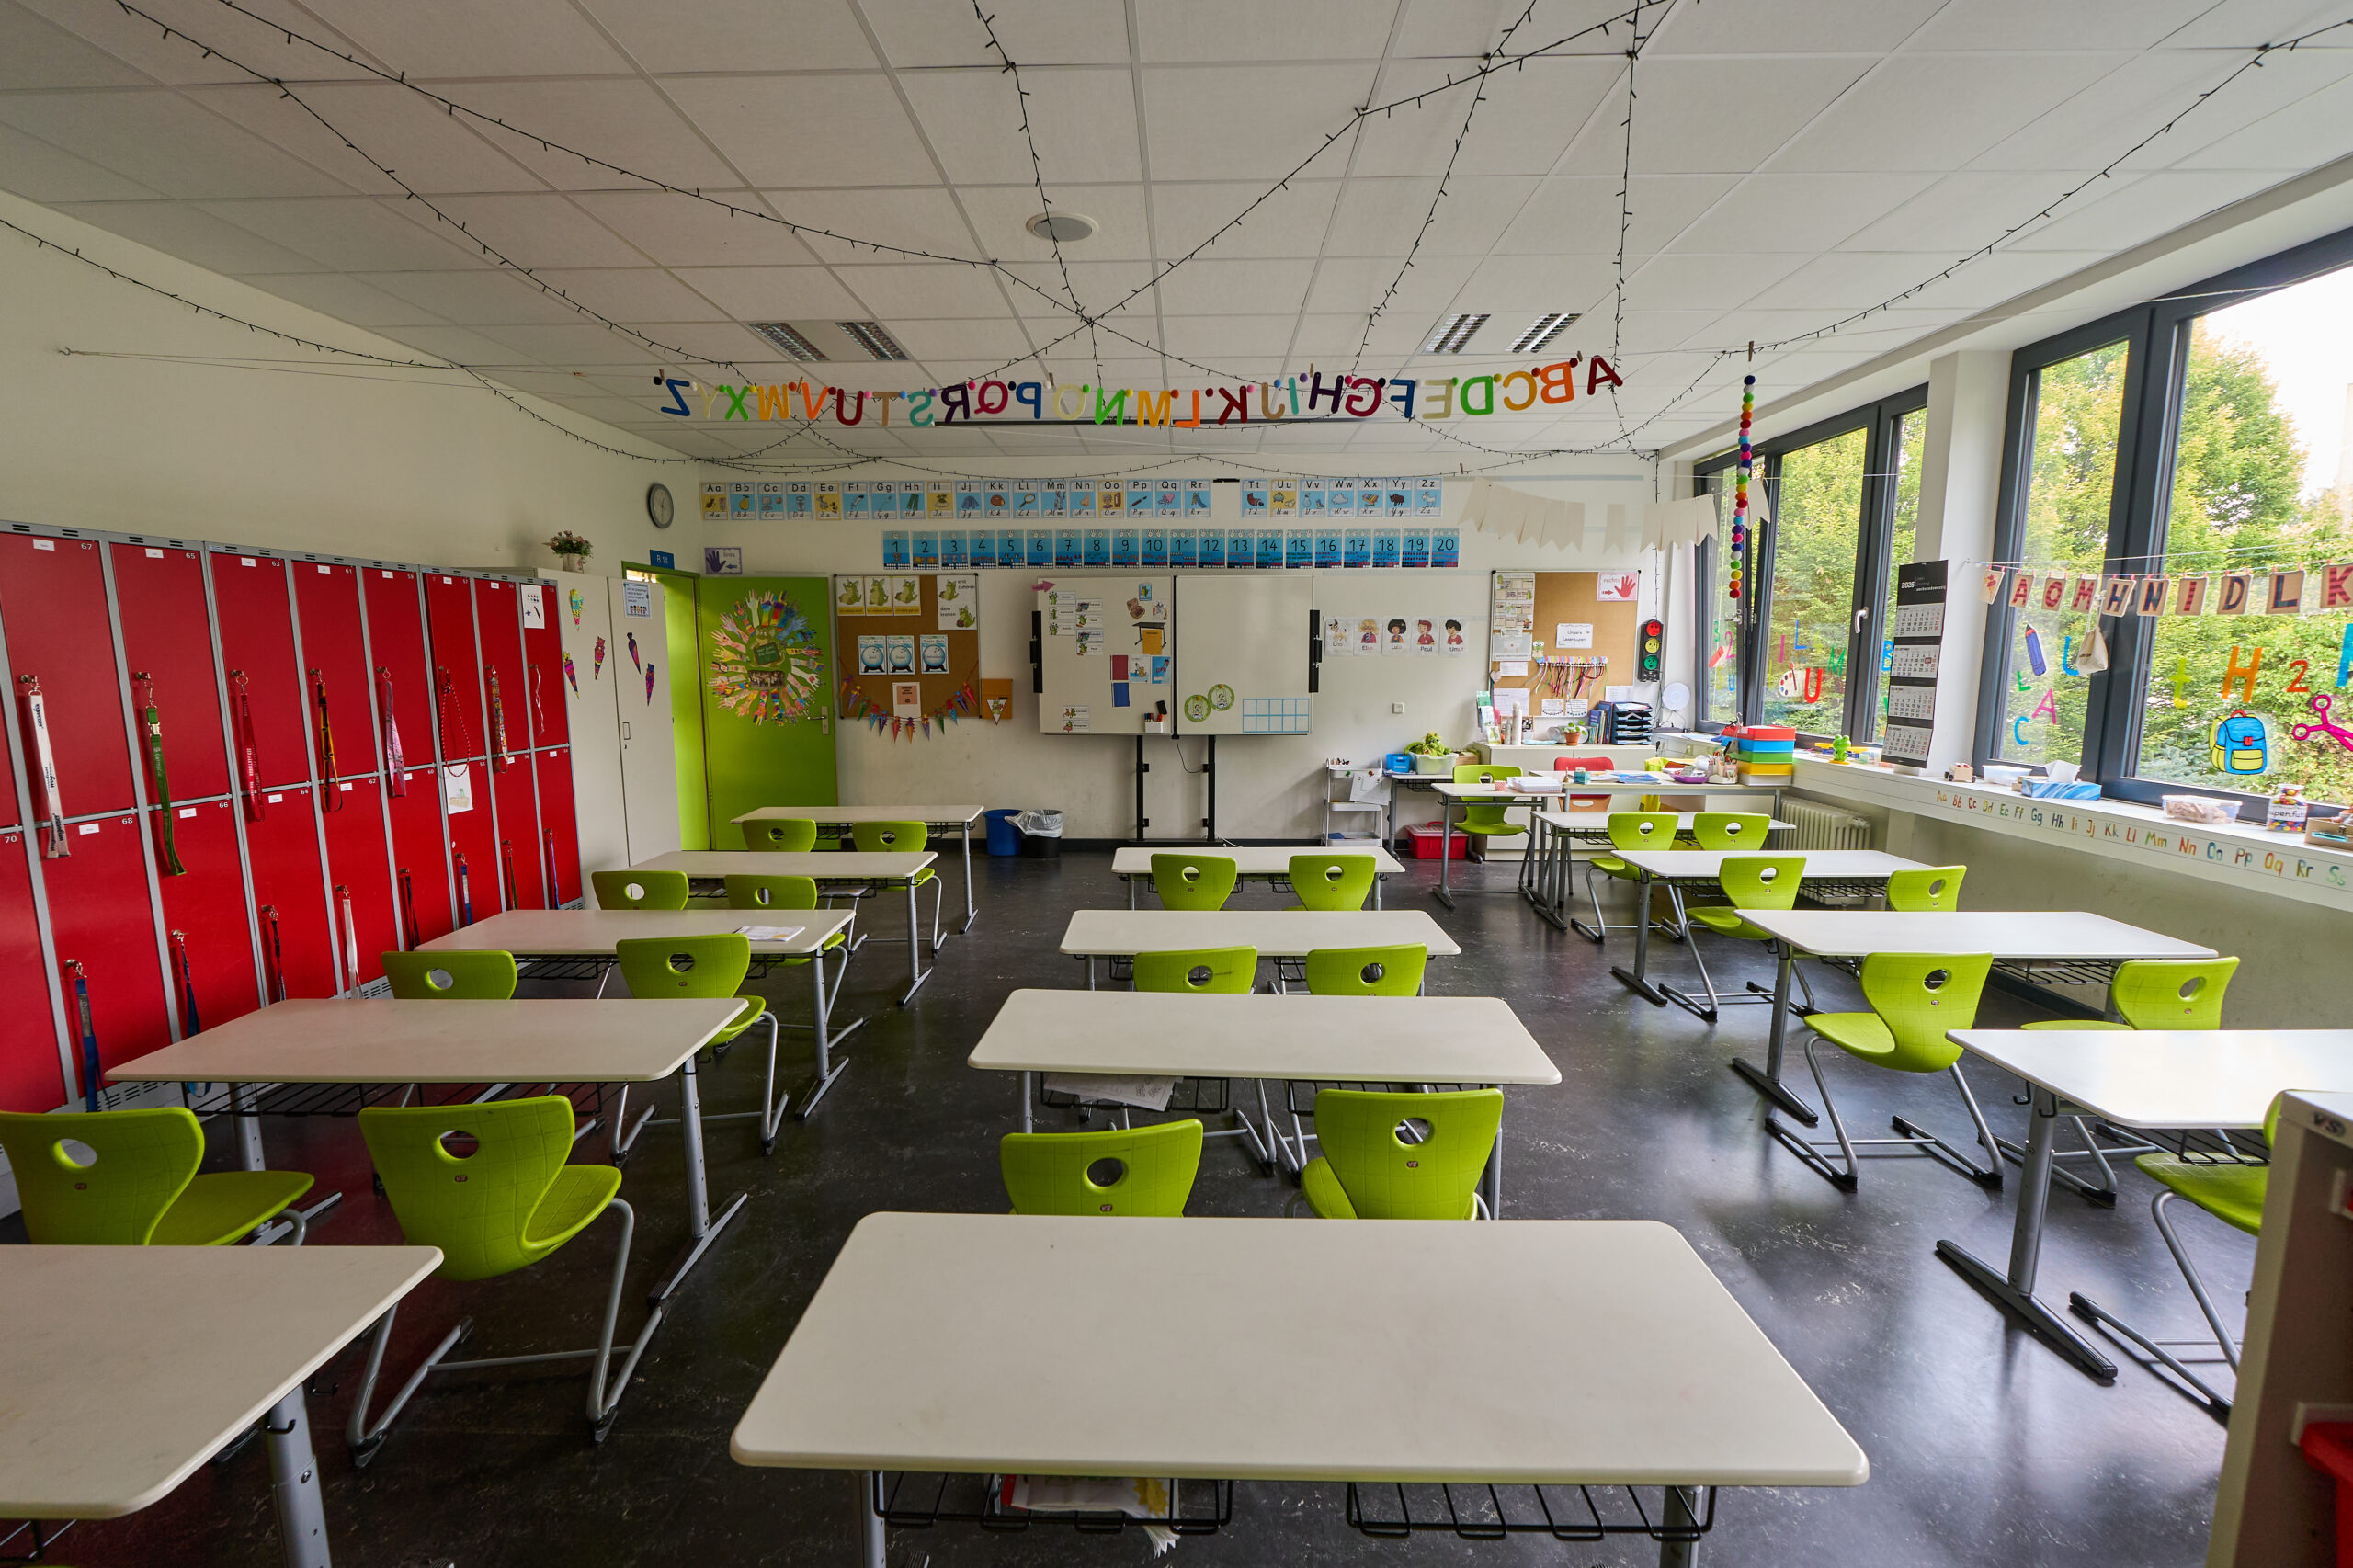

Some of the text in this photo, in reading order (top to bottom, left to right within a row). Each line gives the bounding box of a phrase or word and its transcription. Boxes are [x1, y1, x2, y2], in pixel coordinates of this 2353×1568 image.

[81, 542, 92, 551] 67
[656, 555, 662, 563] B
[892, 539, 1454, 553] 1 2 3 4 5 6 7 8 9 10 11 12 13 14 15 16 17 18 19 20
[2012, 566, 2353, 612] A O M H N I D L K
[1724, 631, 1735, 659] 2
[1794, 619, 1807, 650] L
[1827, 644, 1846, 676] M
[1881, 640, 1893, 671] B
[1728, 674, 1735, 691] U
[1804, 667, 1824, 704] U
[2017, 671, 2031, 691] L
[2222, 645, 2263, 703] H
[2287, 660, 2309, 693] 2
[2031, 687, 2057, 724] A
[2014, 716, 2029, 745] C
[5, 835, 17, 844] 70
[1937, 790, 2346, 886] Aa Bb Cc Dd Ee Ff Gg Hh Ii Jj Kk Ll Mm Nn Oo Pp Qq Rr Ss
